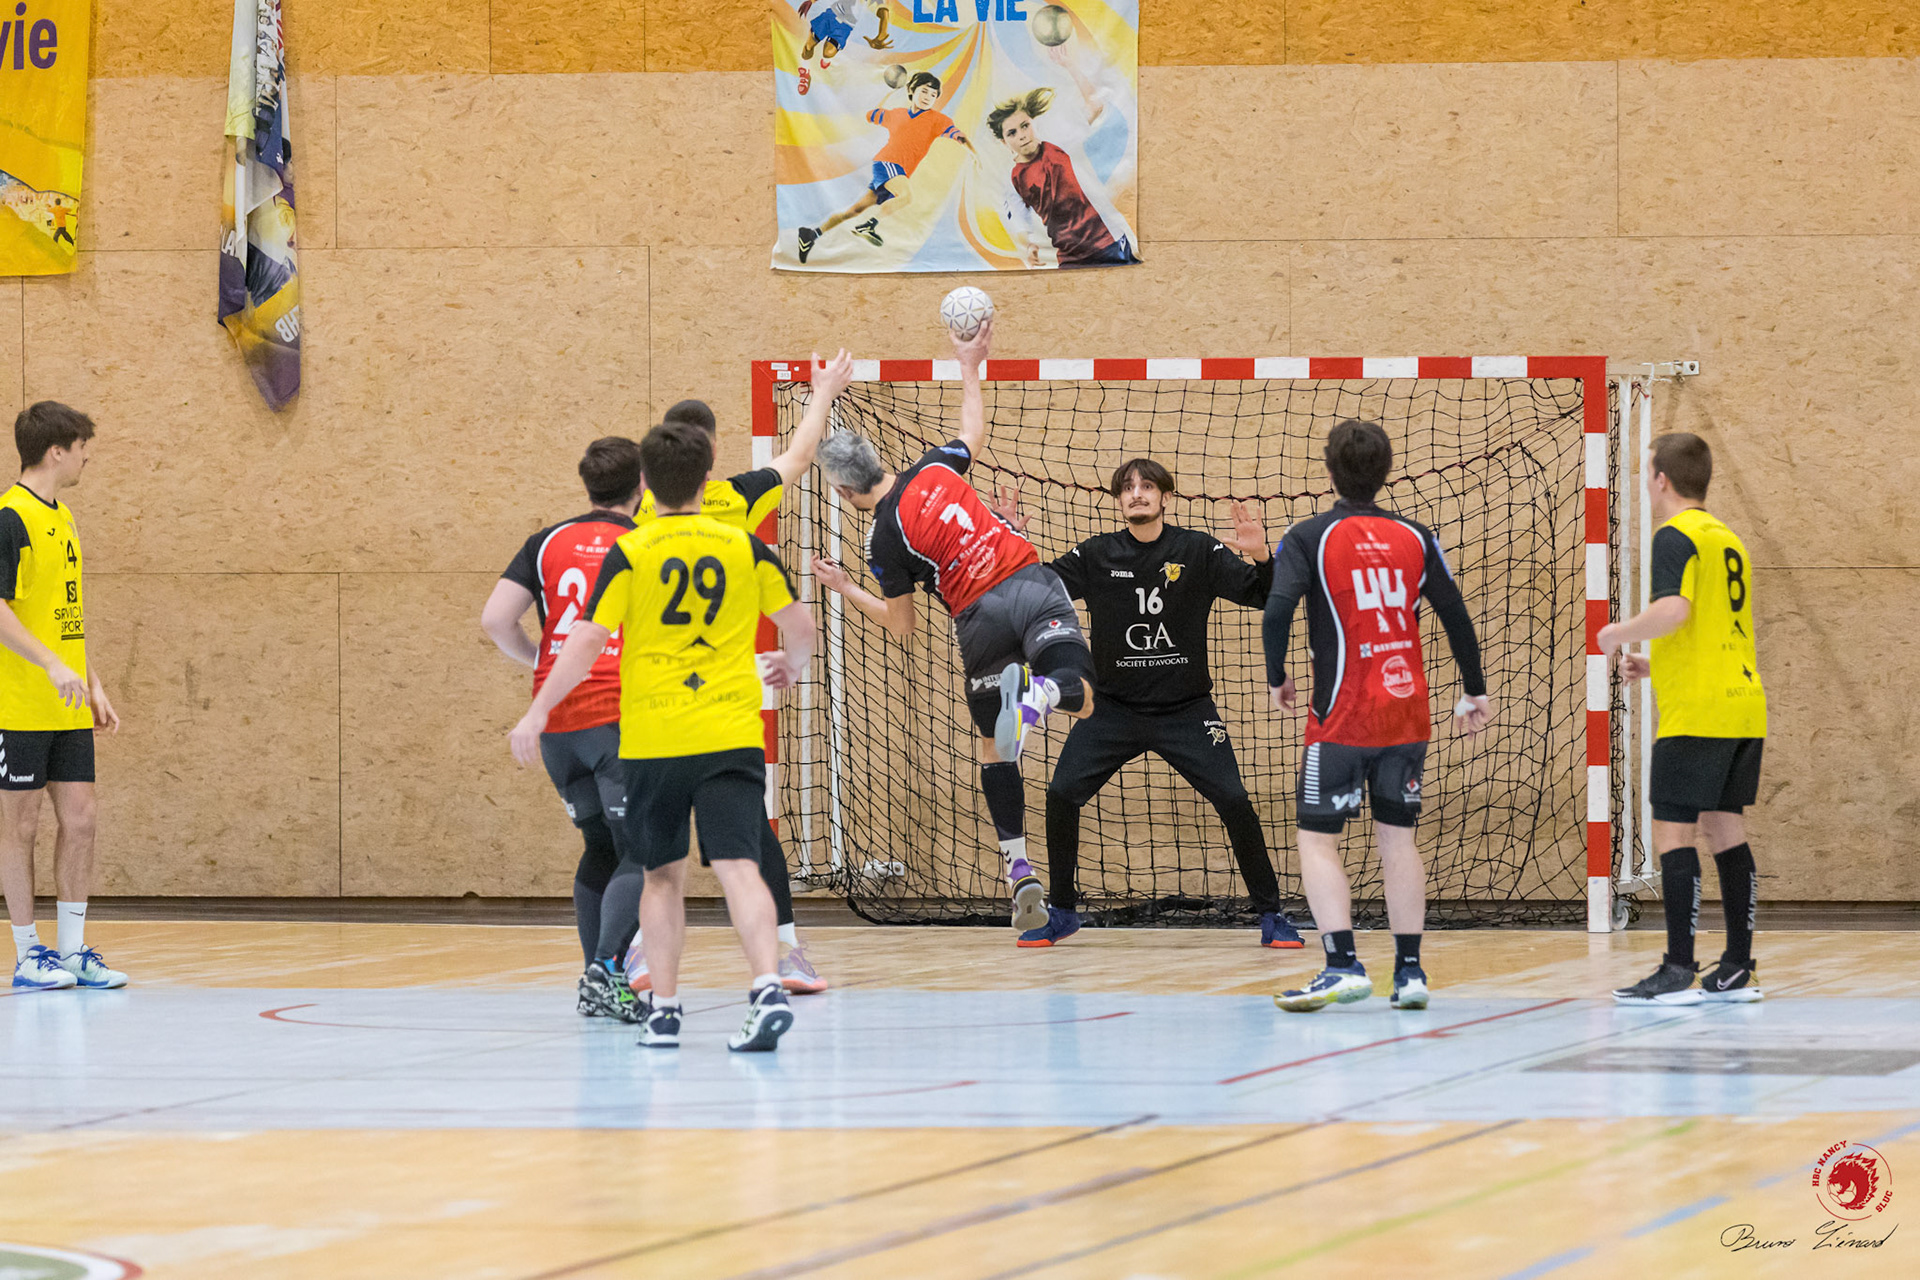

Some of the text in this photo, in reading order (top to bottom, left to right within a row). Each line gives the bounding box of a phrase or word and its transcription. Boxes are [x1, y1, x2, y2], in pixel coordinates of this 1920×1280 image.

[660, 555, 726, 626] 29
[1135, 586, 1164, 615] 16
[1351, 567, 1408, 634] 44
[1723, 546, 1746, 613] 8
[1125, 621, 1177, 651] GA
[1115, 656, 1189, 668] SOCIÉTÉ D'AVOCATS
